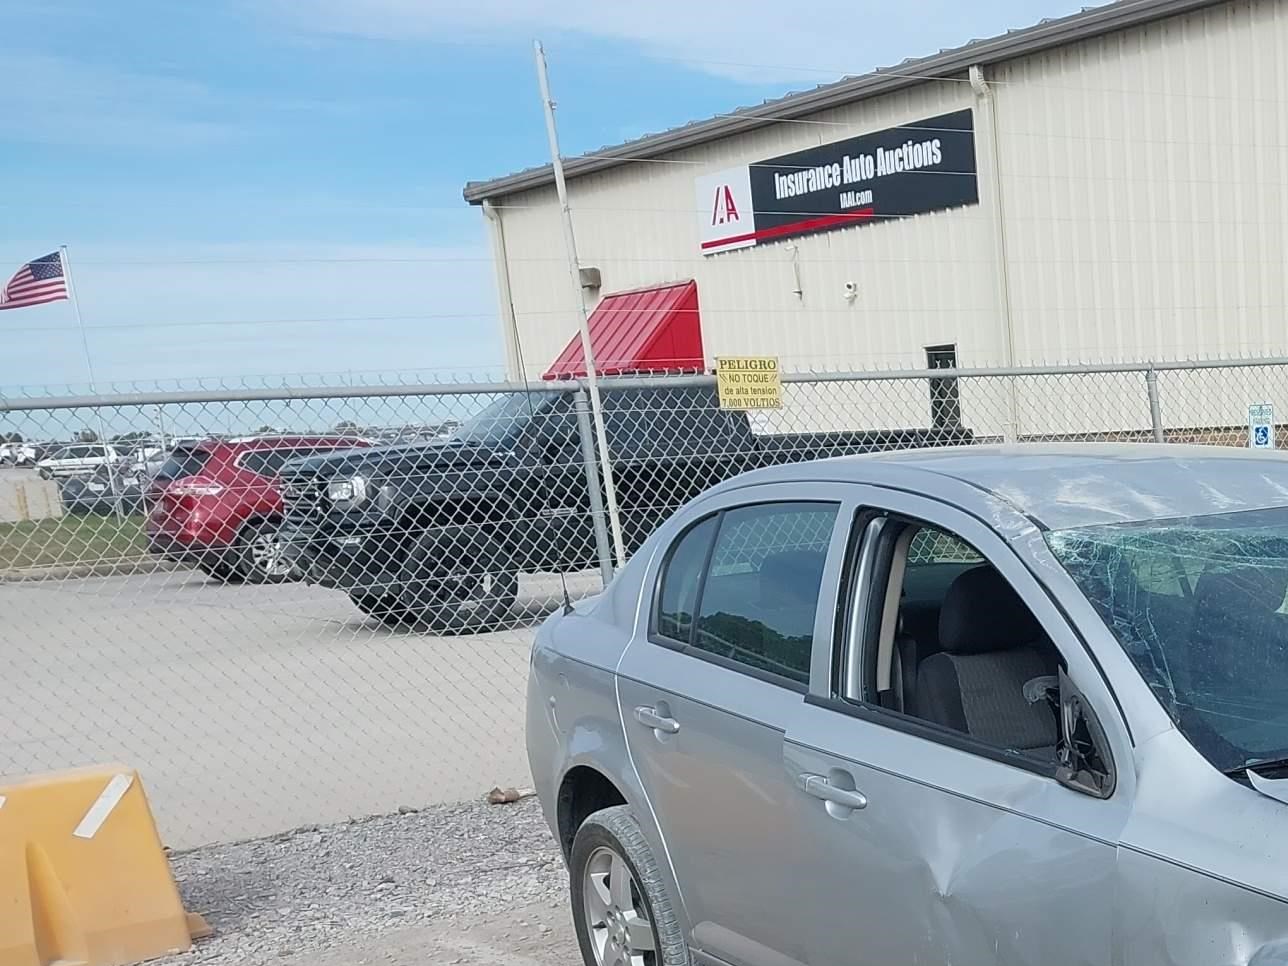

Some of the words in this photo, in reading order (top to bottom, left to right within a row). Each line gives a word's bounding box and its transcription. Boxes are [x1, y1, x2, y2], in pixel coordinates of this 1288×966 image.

[774, 164, 841, 200] Insurance
[843, 154, 875, 185] Auto
[876, 138, 942, 176] Auctions
[719, 359, 777, 370] PELIGRO
[728, 373, 741, 384] NO
[743, 373, 770, 384] TOQUE
[724, 386, 734, 395] de
[735, 386, 749, 395] alta
[743, 397, 780, 408] VOLTIOS
